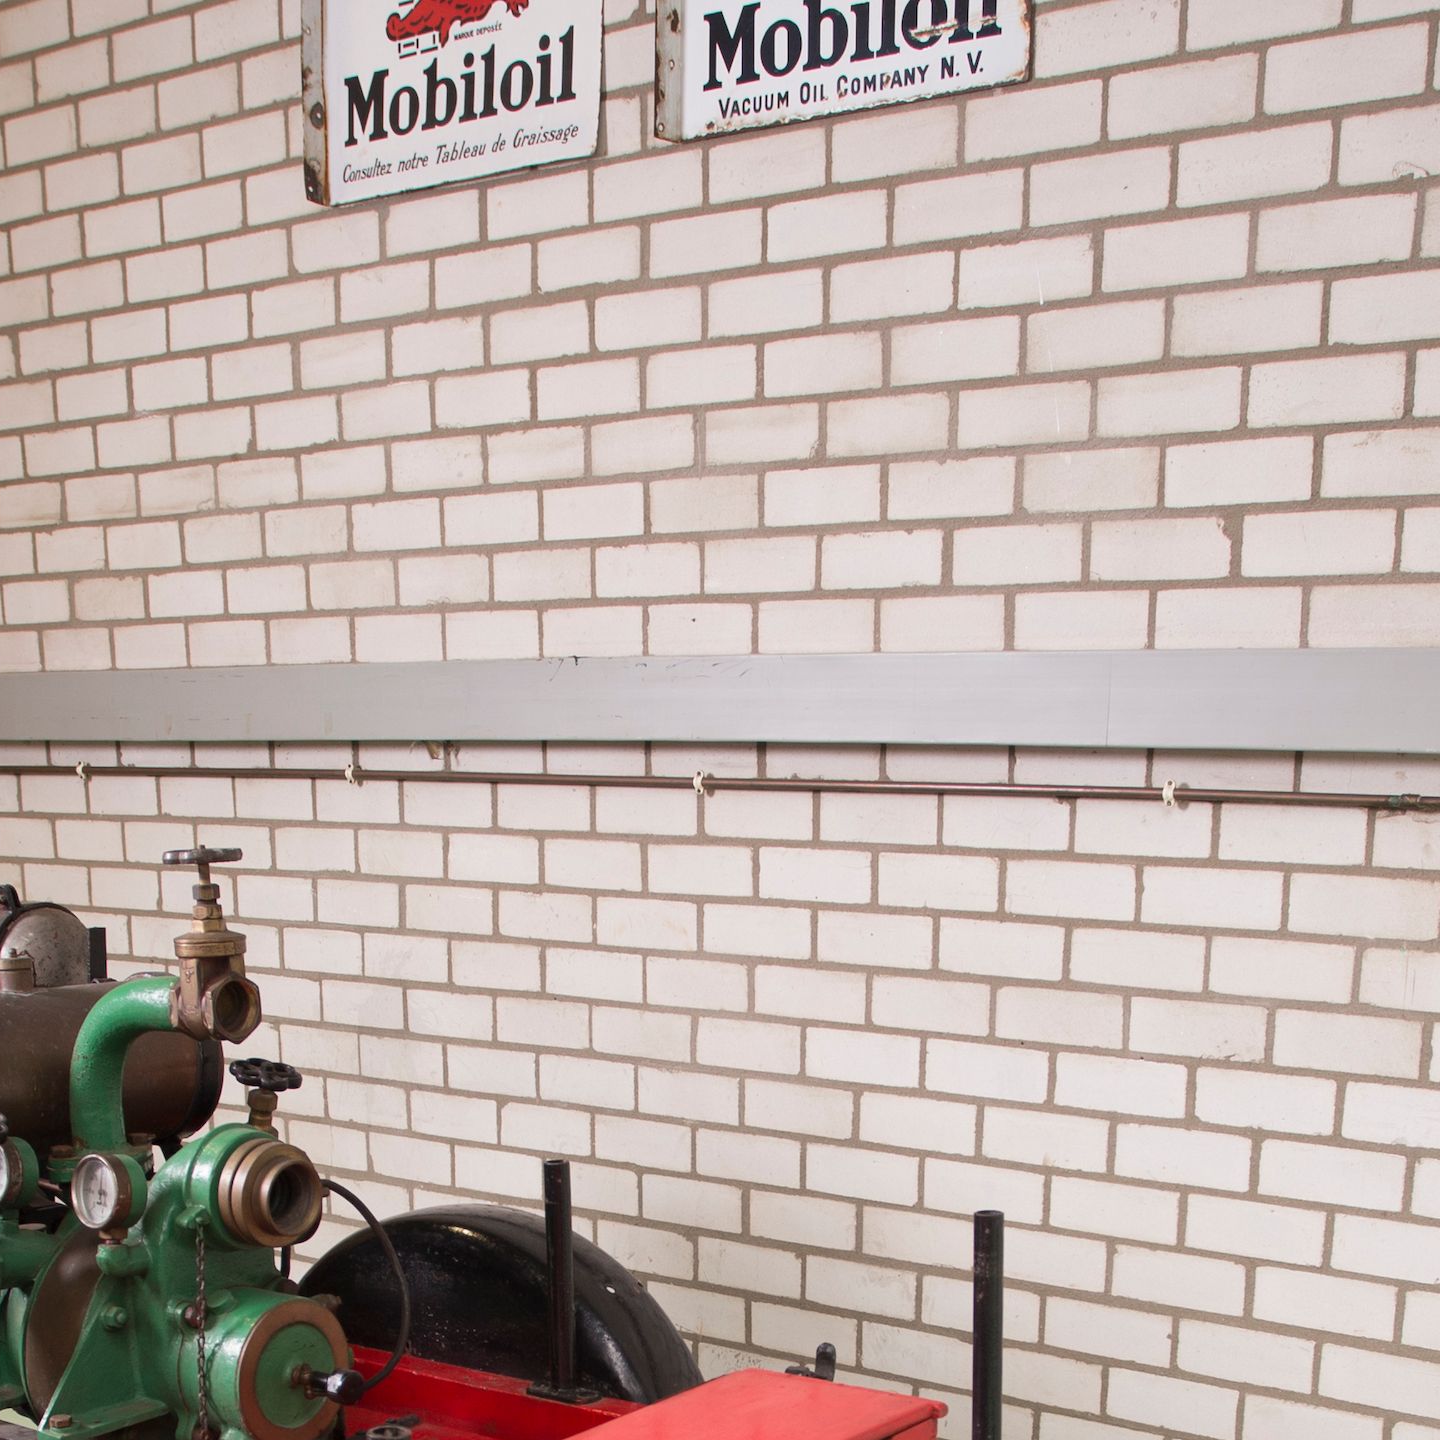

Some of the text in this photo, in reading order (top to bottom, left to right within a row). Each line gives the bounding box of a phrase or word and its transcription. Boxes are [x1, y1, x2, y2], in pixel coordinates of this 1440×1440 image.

[343, 25, 576, 147] Mobiloil
[718, 50, 983, 119] VACUUM OIL COMPANY N. V.
[343, 124, 579, 183] Consultez notre Tableau de Graissage
